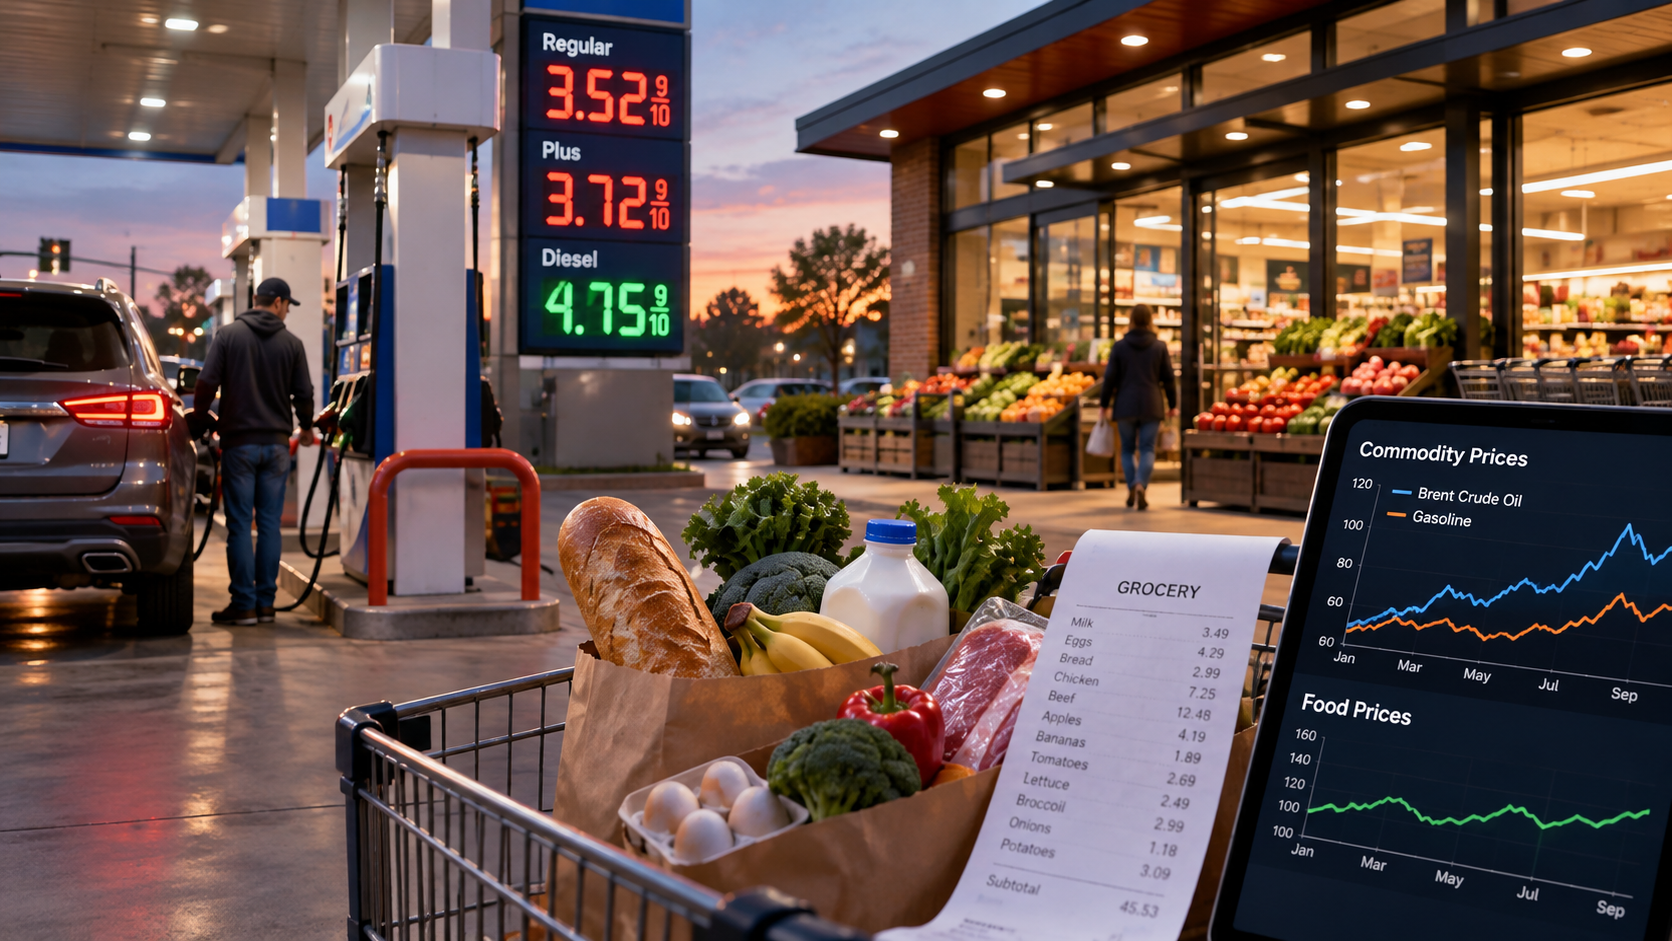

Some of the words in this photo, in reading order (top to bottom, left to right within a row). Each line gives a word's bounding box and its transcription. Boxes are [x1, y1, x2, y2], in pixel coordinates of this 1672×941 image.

[542, 32, 614, 58] Regular
[545, 64, 648, 127] 3.52
[542, 140, 582, 162] Plus
[545, 171, 647, 230] 3.72
[541, 247, 598, 269] Diesel
[544, 280, 646, 337] 4.75
[1359, 441, 1466, 467] Commodity
[1469, 447, 1529, 467] Prices
[1352, 477, 1373, 490] 120
[1417, 486, 1456, 502] Brent
[1458, 489, 1500, 506] Crude
[1503, 493, 1523, 508] Oil
[1343, 519, 1364, 531] 100
[1412, 509, 1472, 528] Gasoline
[1336, 557, 1353, 569] 80
[1117, 580, 1202, 599] GROCERY
[1326, 595, 1344, 608] 60
[1070, 616, 1094, 628] Milk
[1202, 626, 1230, 640] 3.49
[1064, 634, 1093, 649] Eggs
[1197, 646, 1225, 660] 4.29
[1318, 635, 1335, 648] 60
[1059, 652, 1094, 666] Bread
[1192, 666, 1221, 680] 2.99
[1333, 650, 1356, 664] Jan
[1397, 659, 1423, 673] Mar
[1463, 667, 1492, 685] May
[1538, 677, 1560, 692] Jul
[1611, 686, 1639, 704] Sep
[1053, 670, 1100, 687] Chicken
[1189, 685, 1217, 701] 7.25
[1047, 690, 1077, 704] Beef
[1177, 706, 1212, 722] 12.48
[1301, 692, 1350, 717] Food
[1352, 700, 1412, 726] Prices
[1041, 710, 1082, 727] Apples
[1177, 728, 1207, 743] 4.19
[1295, 728, 1317, 742] 160
[1035, 729, 1087, 749] Bananas
[1175, 749, 1202, 765] 1.89
[1290, 752, 1311, 766] 140
[1031, 750, 1089, 771] Tomatoes
[1166, 771, 1197, 788] 2.69
[1023, 771, 1070, 791] Lettuce
[1160, 794, 1191, 810] 2.49
[1284, 776, 1306, 790] 120
[1278, 799, 1300, 813] 100
[1008, 815, 1052, 835] Onions
[1150, 840, 1179, 858] 1.18
[1153, 816, 1185, 834] 2.99
[1273, 824, 1294, 839] 100
[1000, 837, 1056, 859] Potatoes
[1139, 863, 1172, 881] 3.09
[1290, 842, 1315, 858] Jan
[1360, 855, 1388, 872] Mar
[1434, 868, 1466, 889] May
[1516, 885, 1540, 902] Jul
[1596, 898, 1627, 920] Sep
[986, 873, 1042, 896] Subtotal
[1119, 899, 1160, 919] 45.53
